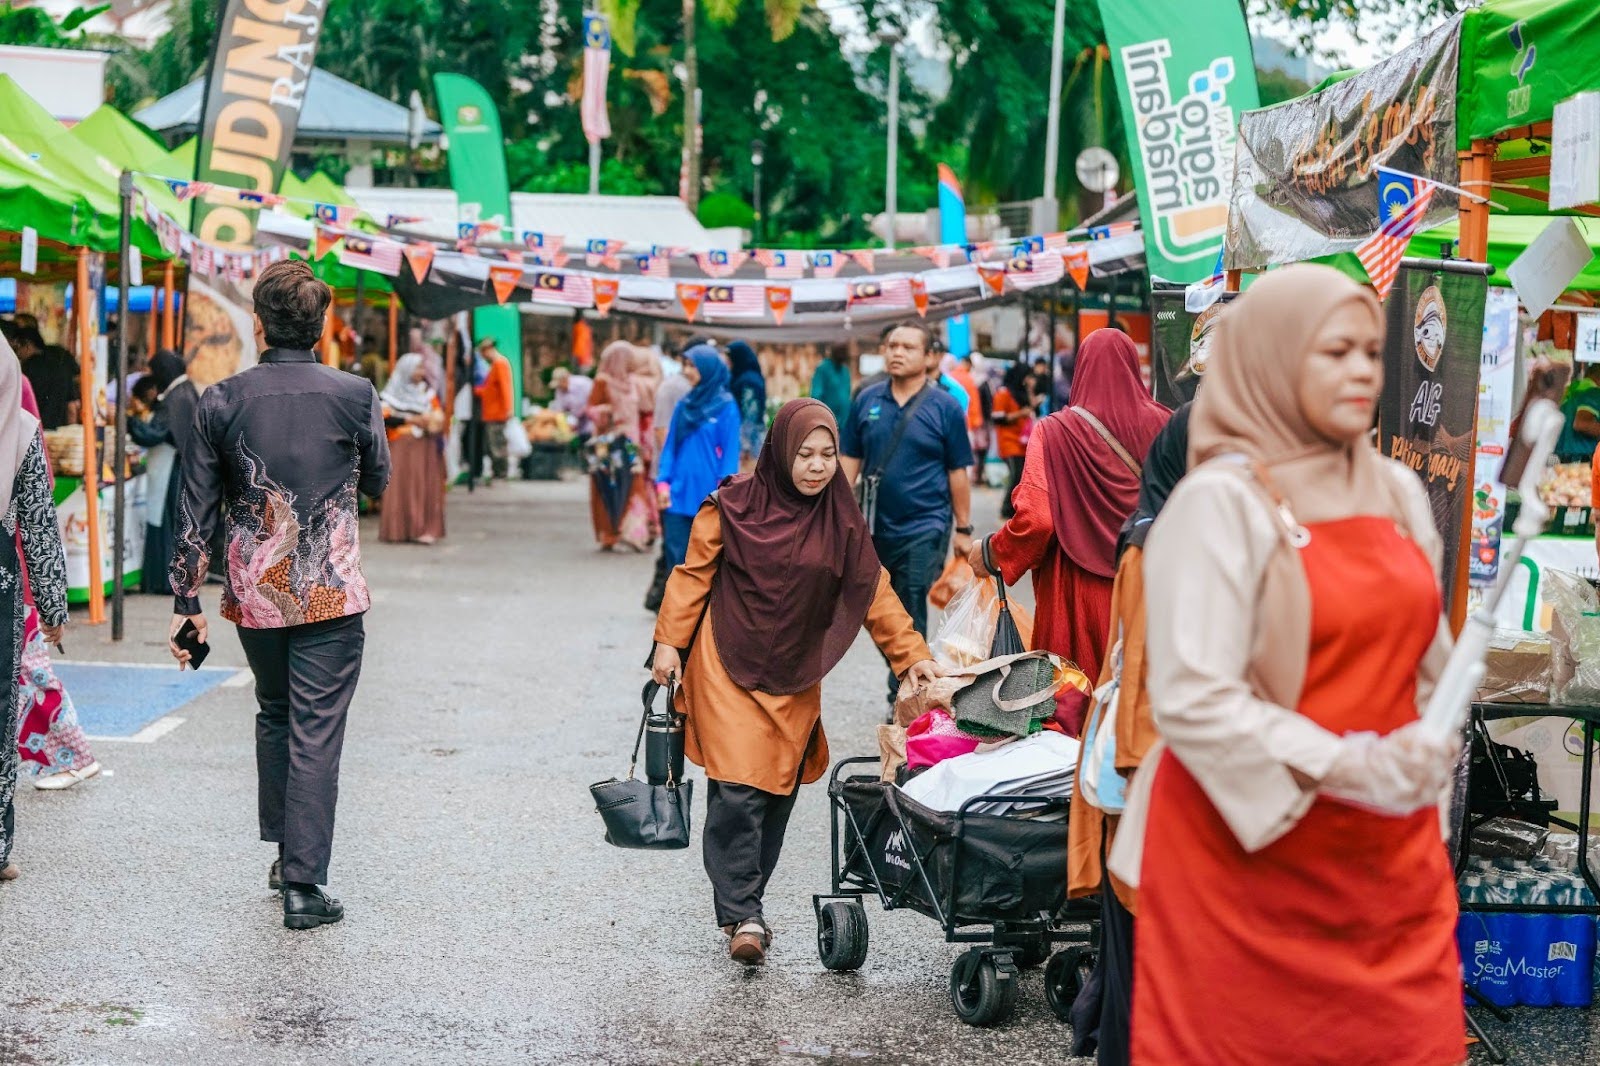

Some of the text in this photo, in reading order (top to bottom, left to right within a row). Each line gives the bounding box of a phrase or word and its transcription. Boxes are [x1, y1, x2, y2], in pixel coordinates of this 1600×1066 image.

[269, 0, 323, 111] RAJ
[1409, 380, 1442, 427] ALG
[1472, 954, 1563, 979] SeaMaster
